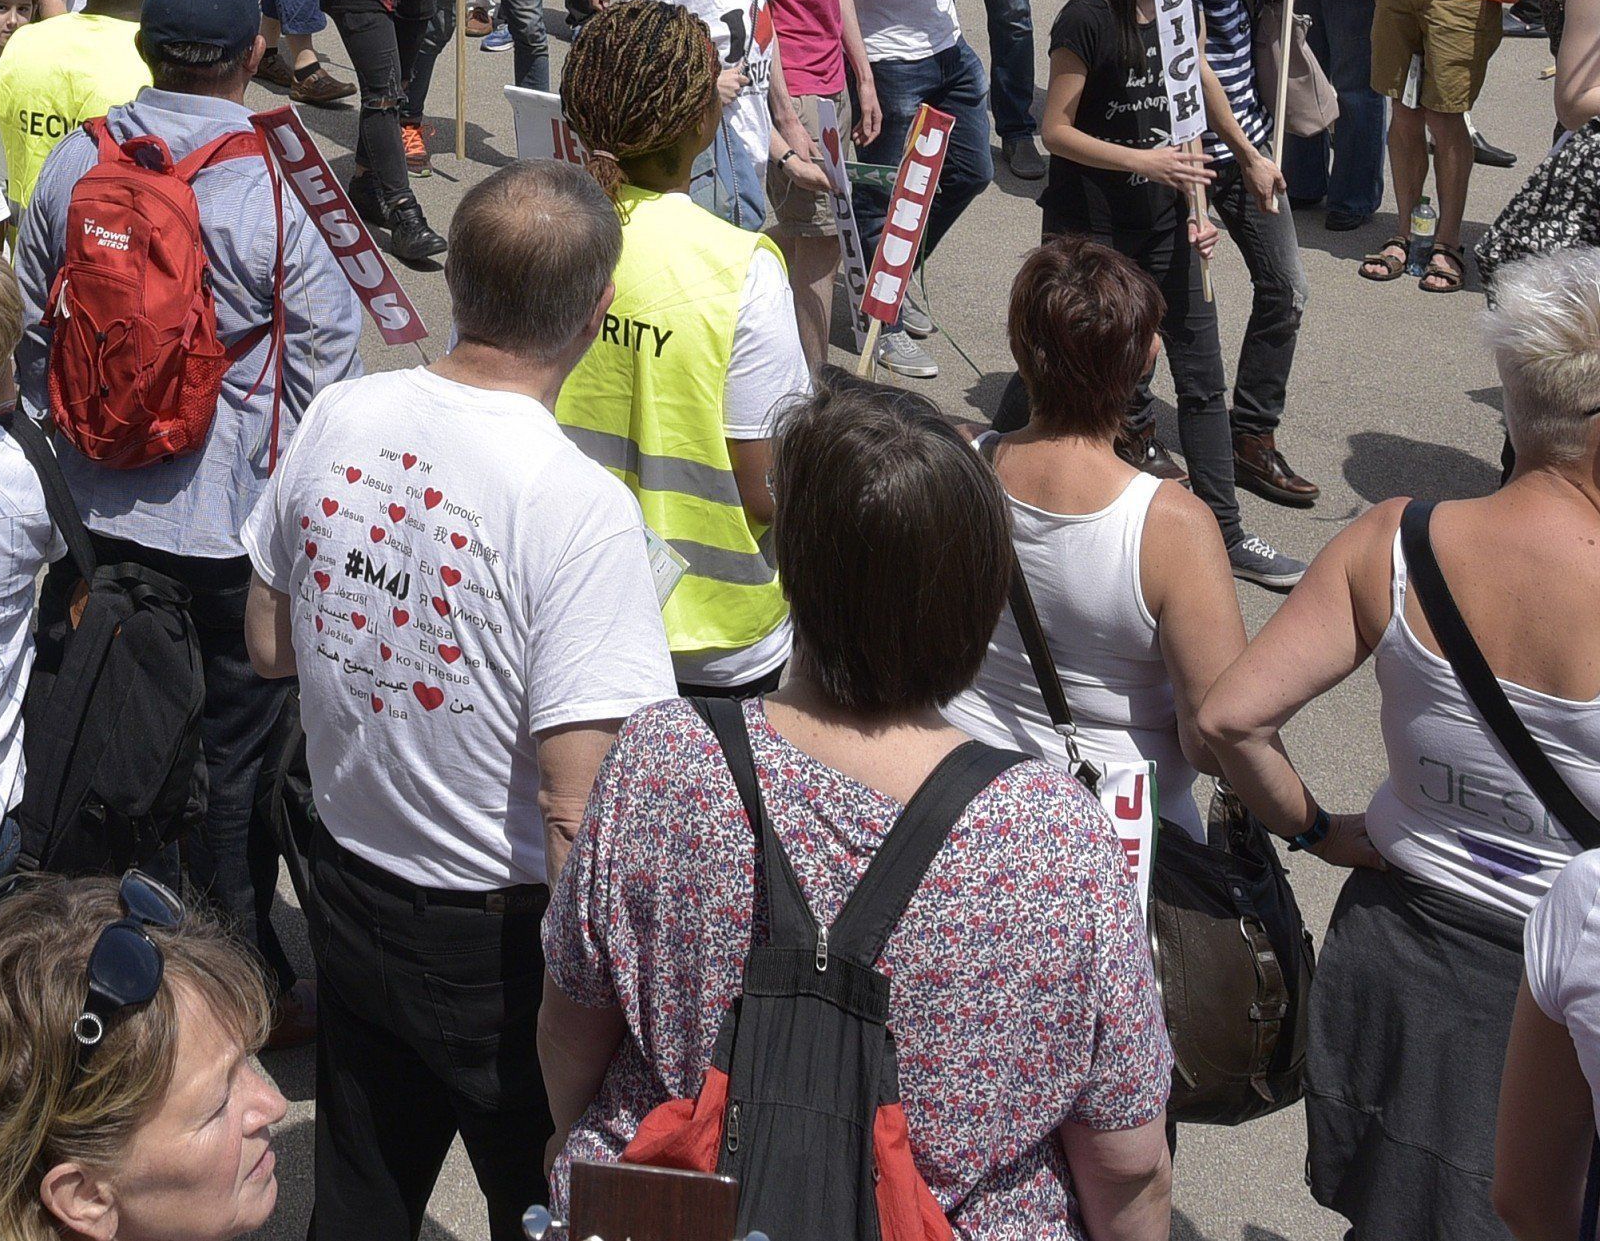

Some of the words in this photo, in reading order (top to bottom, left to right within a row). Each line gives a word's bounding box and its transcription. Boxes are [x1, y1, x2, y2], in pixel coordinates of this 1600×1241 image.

[83, 223, 130, 244] V-Power
[276, 122, 411, 331] JESUS
[870, 127, 946, 306] JESUS
[330, 461, 346, 477] Ich
[362, 474, 394, 495] Jesus
[404, 513, 426, 533] Jesus
[343, 547, 411, 601] #M4J
[419, 559, 435, 576] Eu
[463, 579, 502, 601] Jesus
[419, 639, 436, 656] Eu
[395, 654, 411, 668] ko
[414, 659, 425, 672] si
[427, 664, 471, 686] Hesus
[350, 683, 370, 702] ben
[388, 704, 409, 720] Isa
